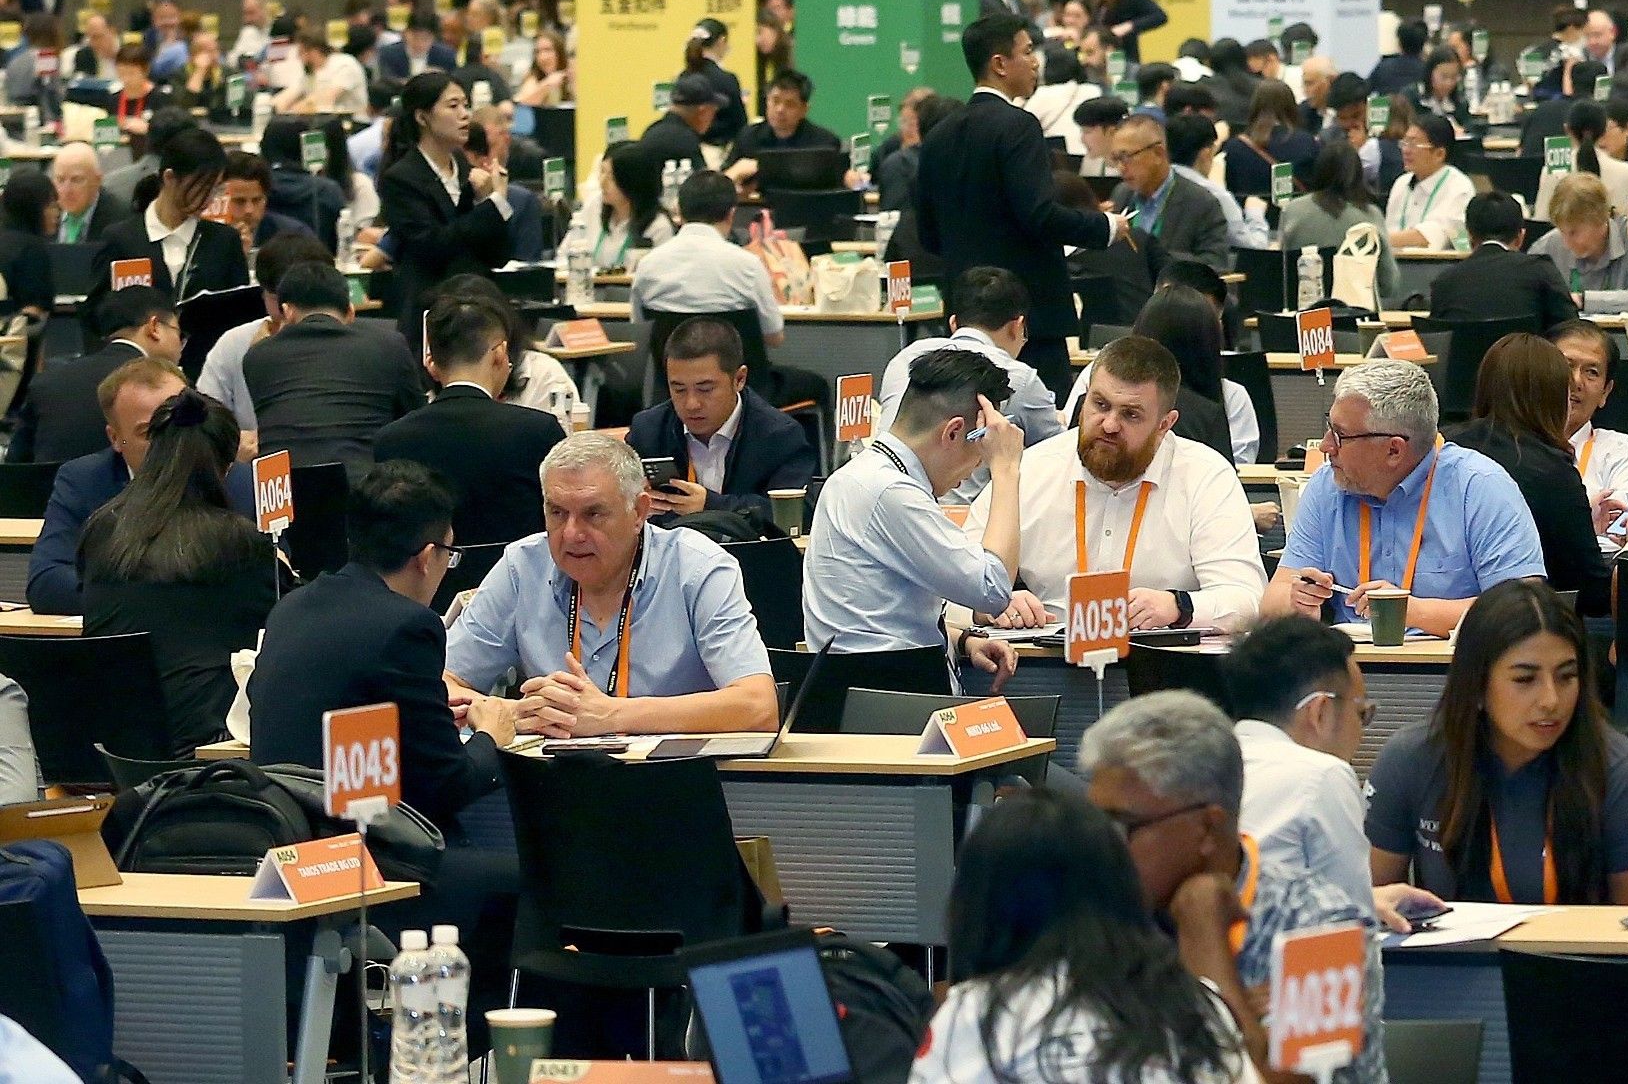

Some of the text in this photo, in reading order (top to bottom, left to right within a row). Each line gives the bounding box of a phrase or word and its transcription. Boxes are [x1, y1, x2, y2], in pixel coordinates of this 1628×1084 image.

[1302, 325, 1333, 357] A084
[840, 395, 871, 427] A074
[259, 474, 292, 516] A064
[1070, 596, 1129, 644] A053
[331, 737, 398, 795] A043
[1282, 964, 1362, 1039] A032
